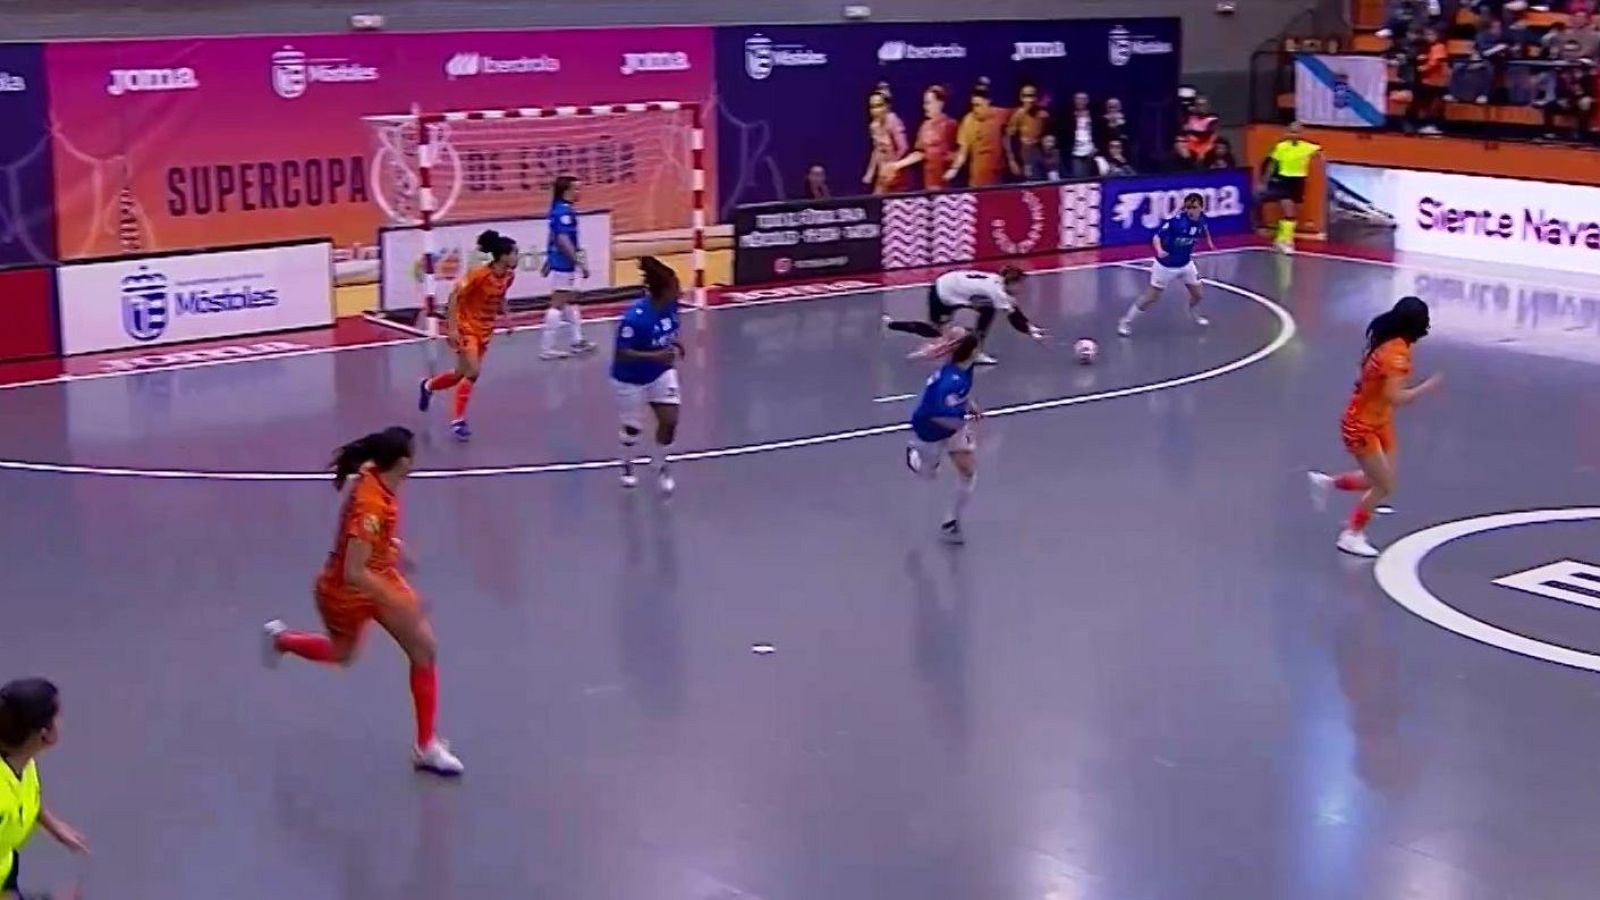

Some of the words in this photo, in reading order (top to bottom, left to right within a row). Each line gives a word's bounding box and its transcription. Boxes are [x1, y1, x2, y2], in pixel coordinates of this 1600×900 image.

[166, 156, 370, 217] SUPERCOPA
[1418, 196, 1513, 239] Siente
[1523, 207, 1600, 250] Nava
